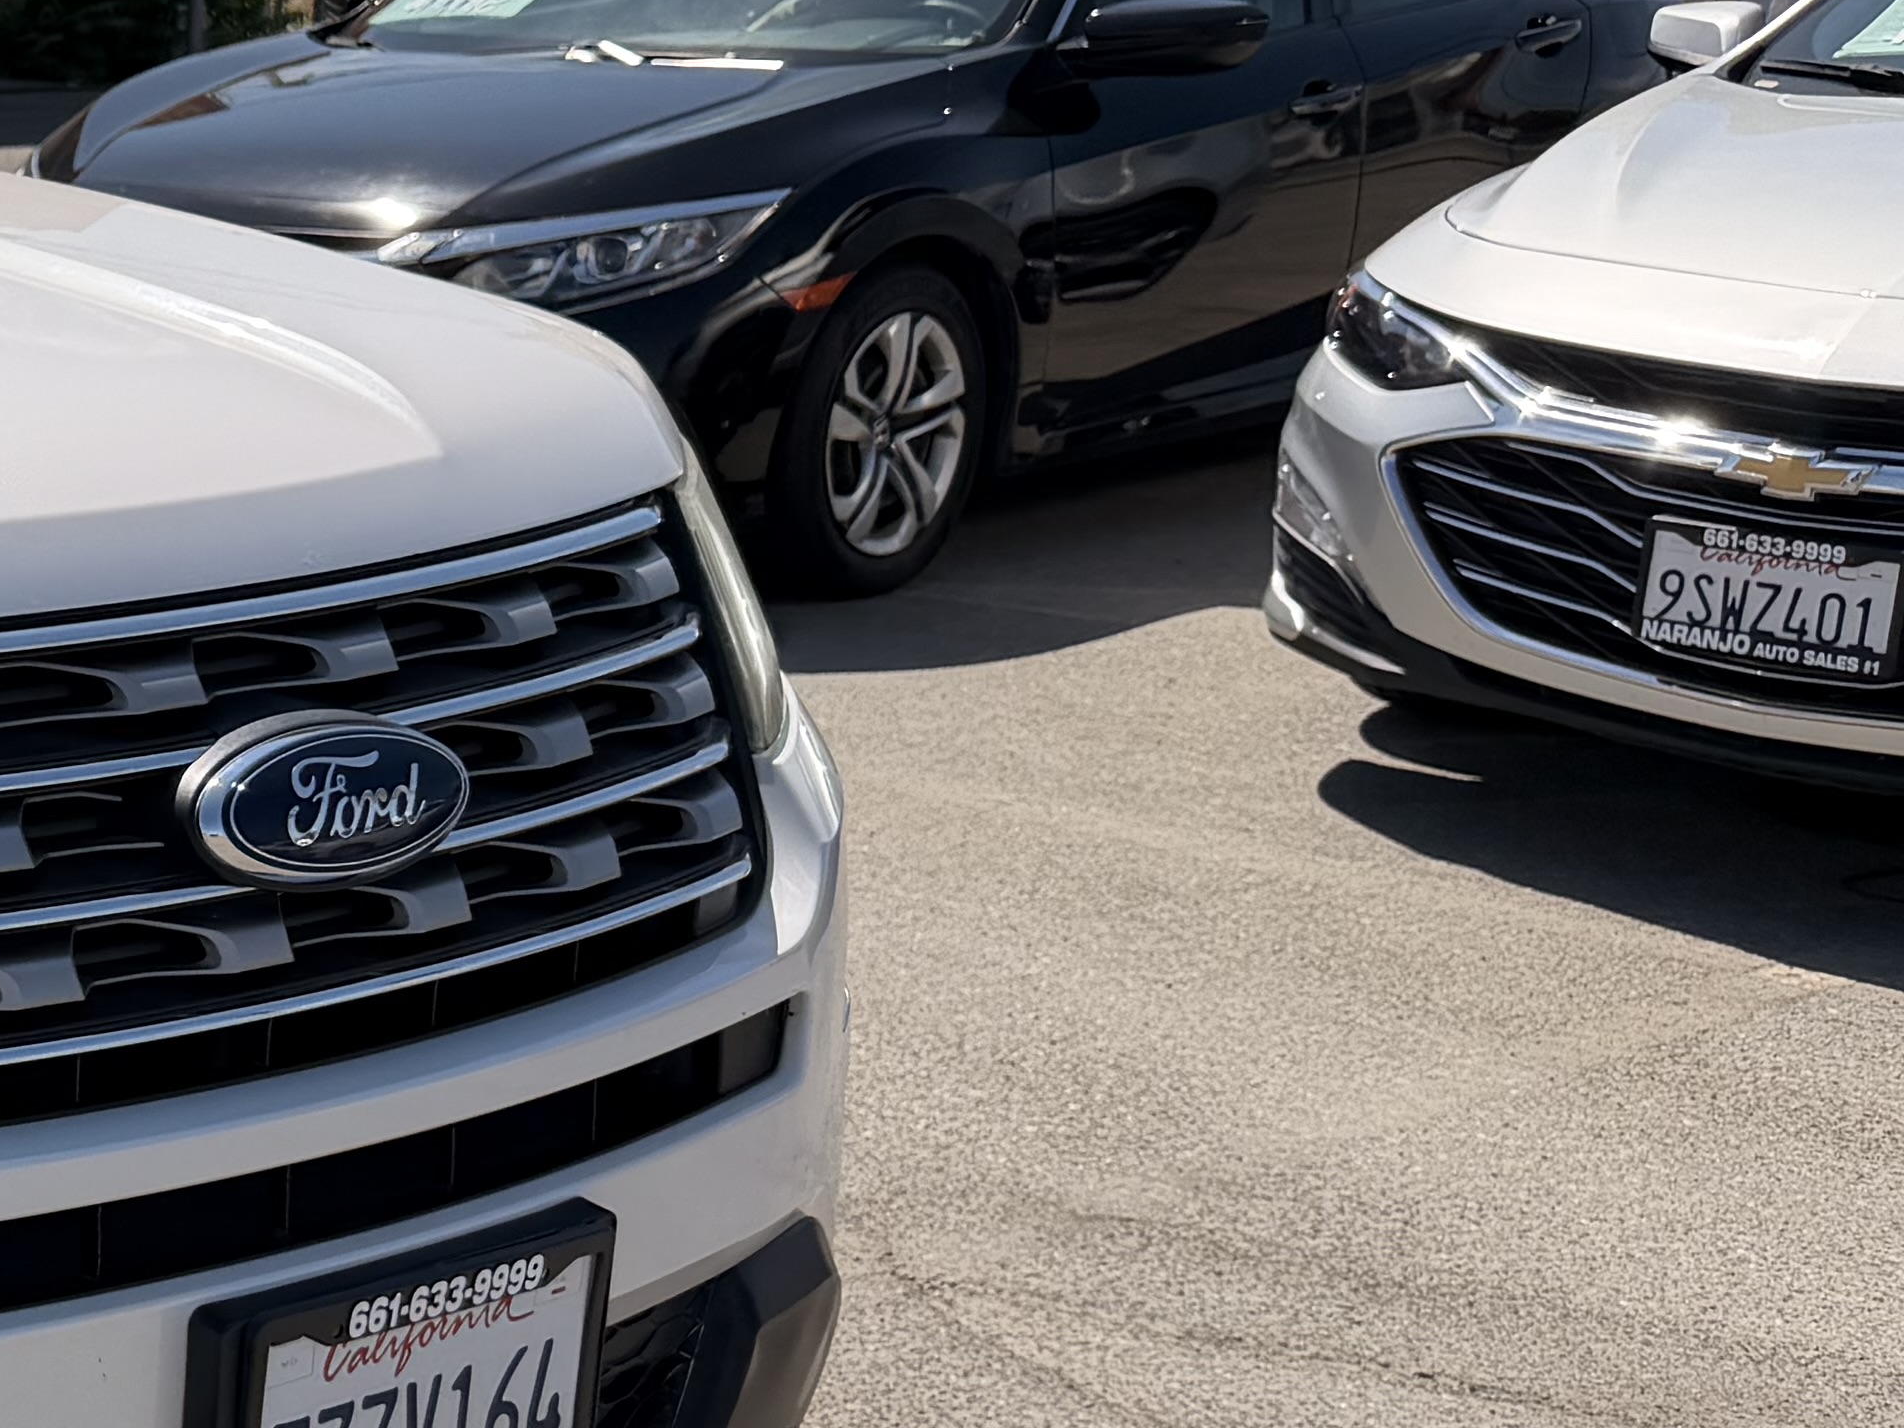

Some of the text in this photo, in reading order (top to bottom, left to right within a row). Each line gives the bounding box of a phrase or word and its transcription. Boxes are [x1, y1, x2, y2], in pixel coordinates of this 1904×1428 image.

[1703, 528, 1847, 564] 661-633-9999
[1641, 618, 1751, 655] NARANJO
[1753, 642, 1799, 664] AUTO
[1802, 649, 1859, 673] SALES
[1653, 569, 1873, 649] 9SWZ401
[287, 750, 426, 847] Ford
[348, 1253, 547, 1339] 661-633-9999
